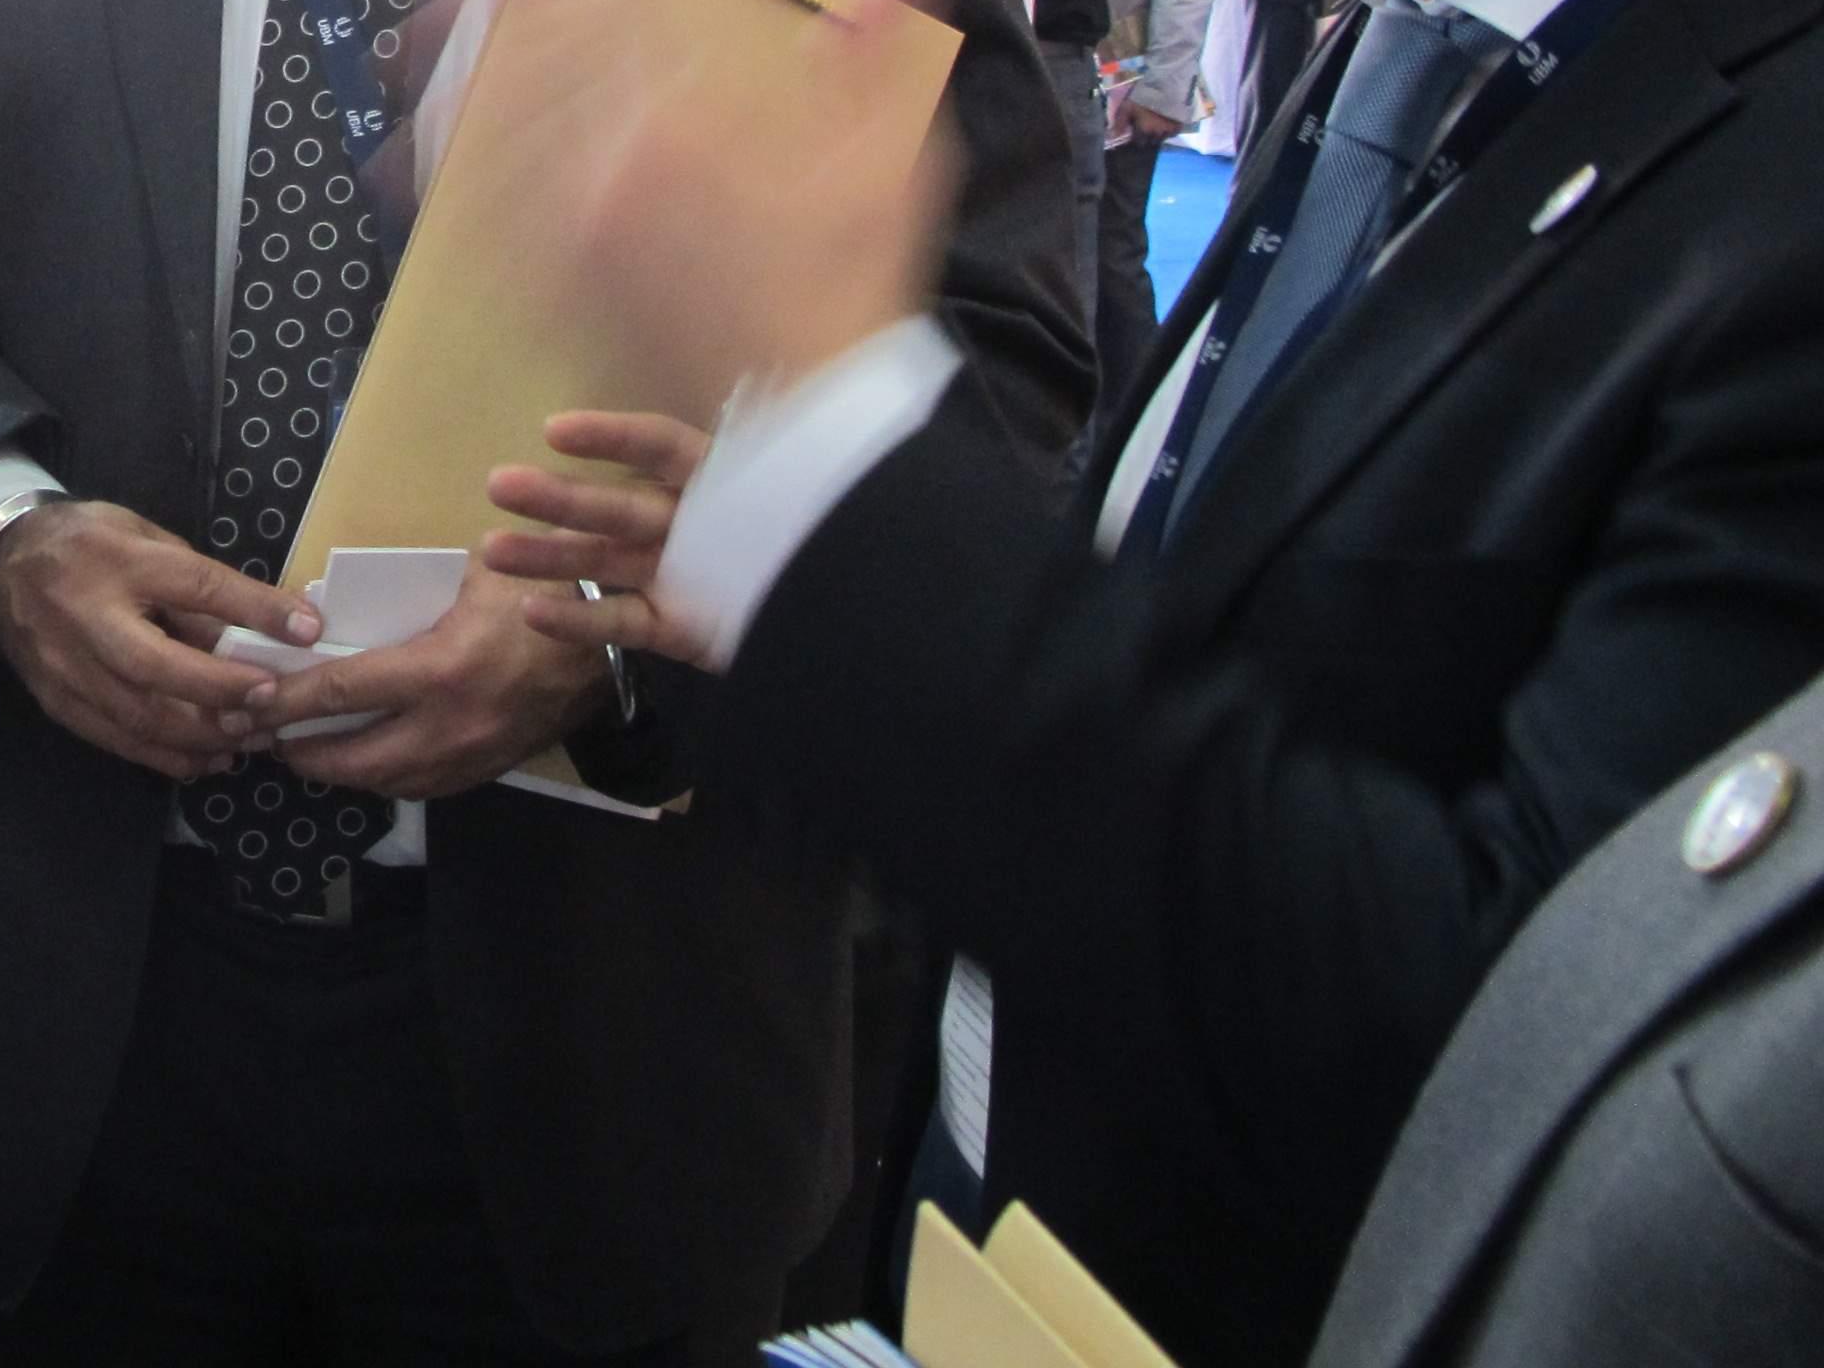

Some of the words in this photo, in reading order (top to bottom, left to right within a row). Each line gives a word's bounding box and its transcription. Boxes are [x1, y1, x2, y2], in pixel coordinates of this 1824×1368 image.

[317, 19, 335, 46] UBM
[1528, 52, 1559, 86] UBM
[345, 110, 364, 137] UBM
